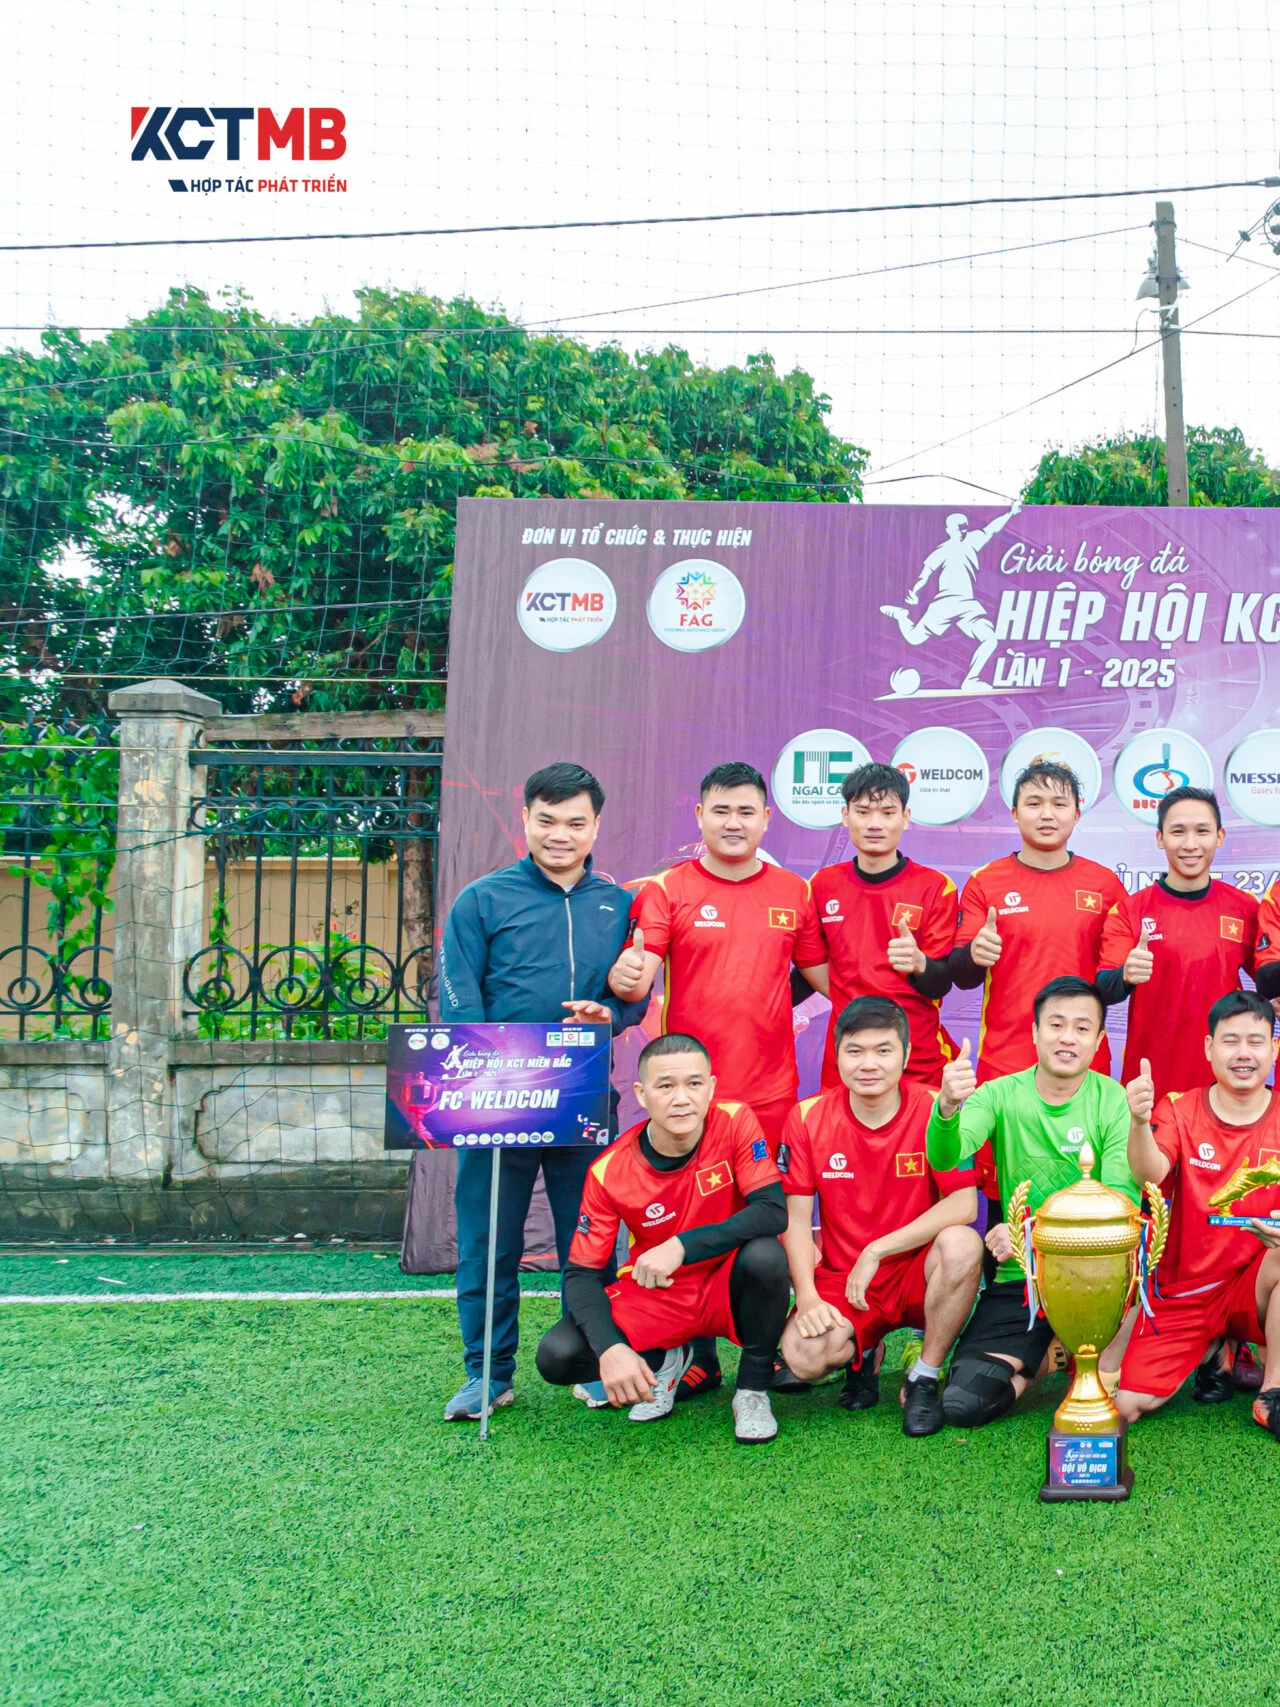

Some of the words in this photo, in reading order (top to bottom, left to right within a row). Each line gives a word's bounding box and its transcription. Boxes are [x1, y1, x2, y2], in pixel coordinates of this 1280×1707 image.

[521, 526, 556, 545] ĐƠN
[560, 528, 577, 547] VỊ
[581, 522, 605, 546] TỔ
[605, 524, 648, 546] CHỨC
[673, 528, 712, 548] THỰC
[716, 526, 753, 549] HIỆN
[1000, 543, 1068, 575] Giải
[1073, 544, 1144, 590] bóng
[1150, 541, 1190, 575] đá
[526, 592, 604, 611] KCTMB
[680, 613, 713, 627] FAG
[997, 581, 1106, 648] HIỆP
[1119, 582, 1208, 650] HỘI
[993, 648, 1046, 688] LẦN
[1057, 657, 1071, 688] 1
[1101, 658, 1177, 689] 2025
[920, 768, 983, 781] WELDCOM
[792, 786, 823, 796] NGAI
[826, 786, 842, 796] CA
[1132, 799, 1159, 810] DUC
[439, 1090, 464, 1110] FC
[470, 1089, 560, 1110] WELDCOM
[1189, 1157, 1221, 1171] WELDCOM
[822, 1171, 854, 1179] WELDCOM
[641, 1211, 676, 1228] WELDCOM
